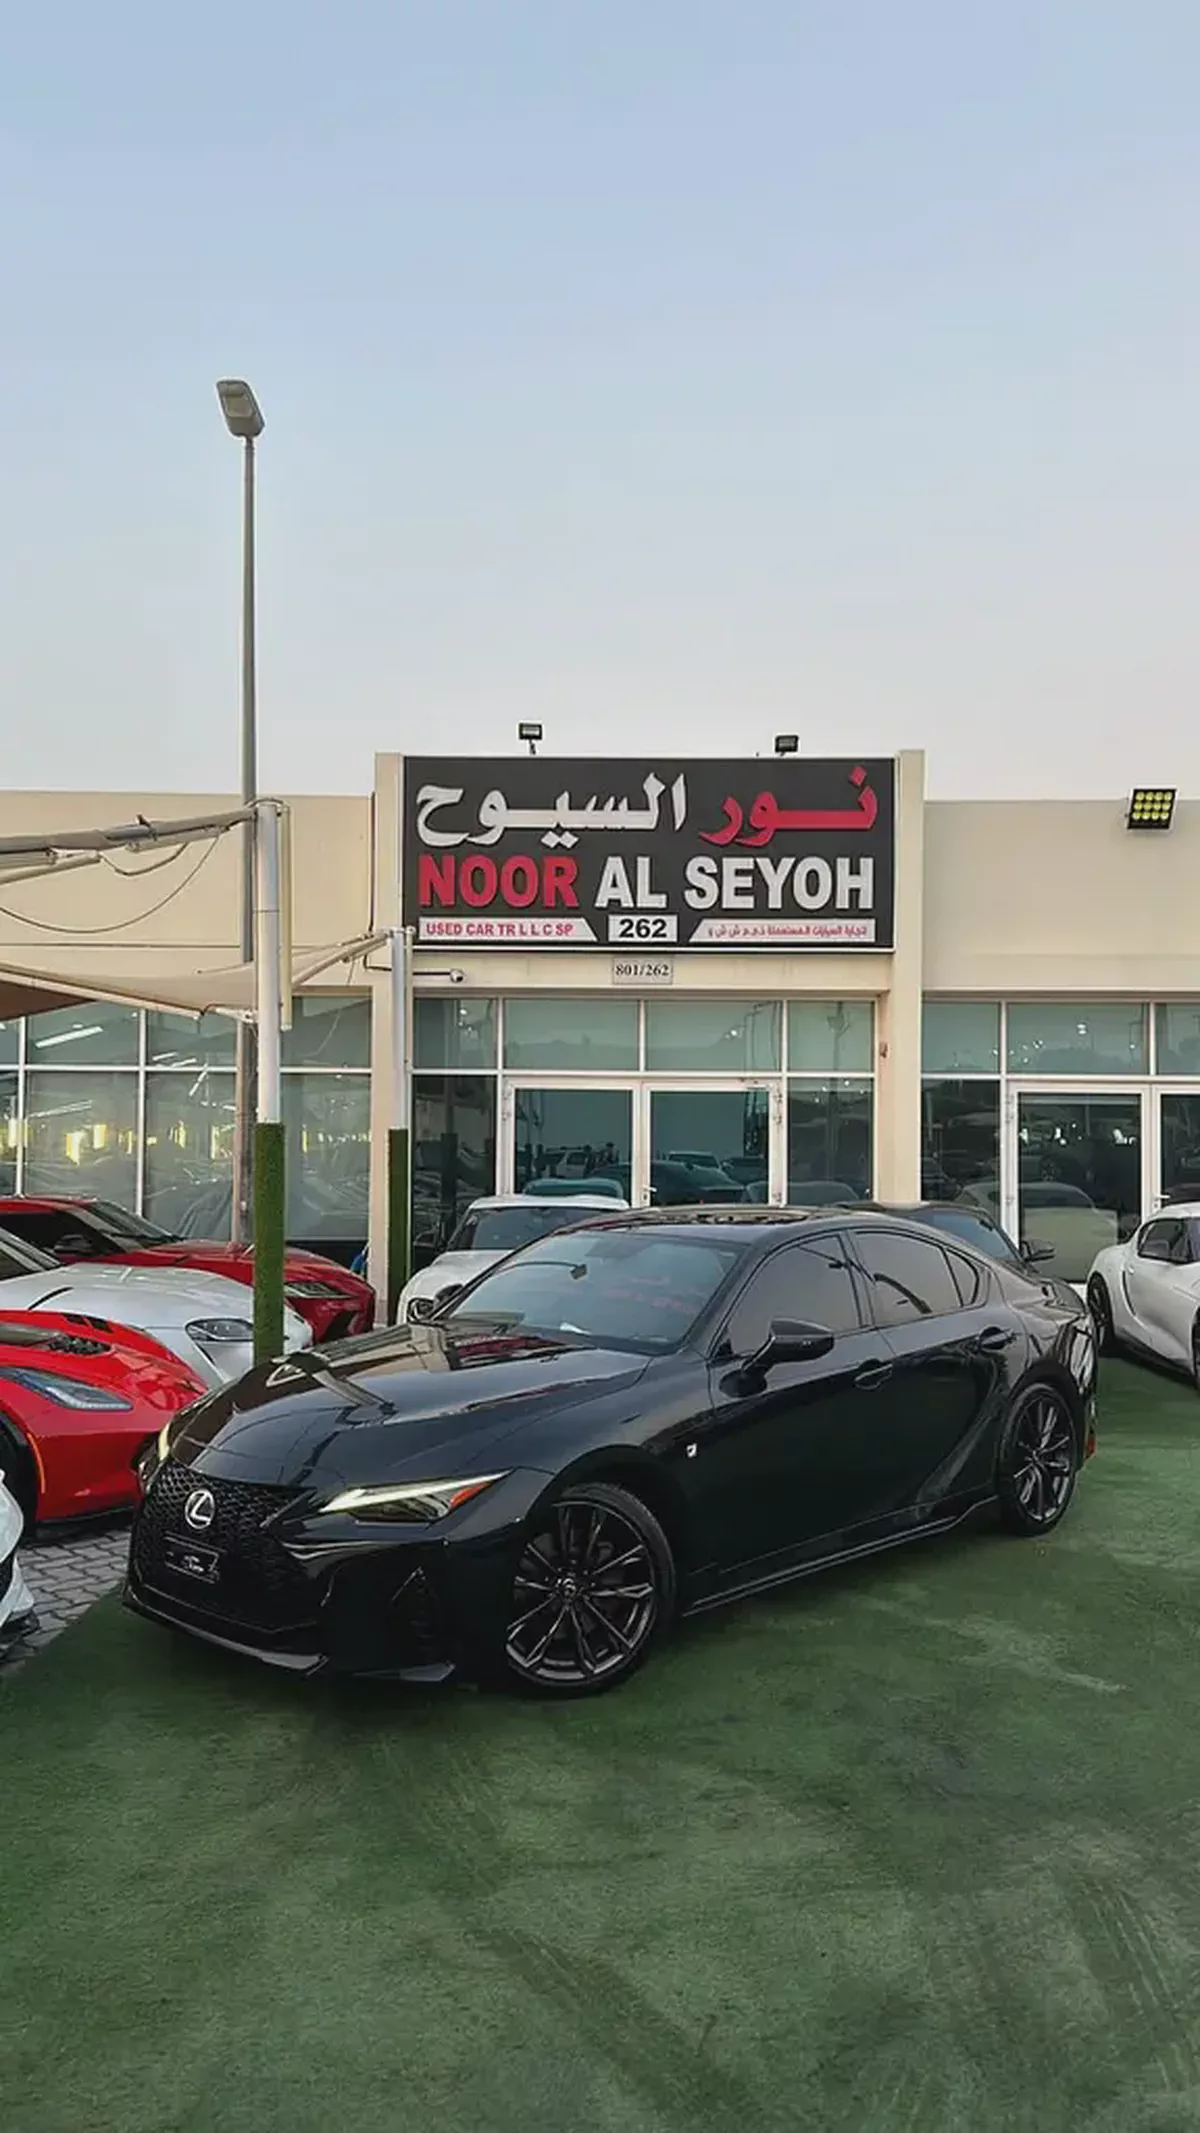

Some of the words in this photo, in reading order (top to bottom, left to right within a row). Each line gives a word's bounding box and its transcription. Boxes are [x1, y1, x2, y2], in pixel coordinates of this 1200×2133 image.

[416, 772, 687, 849] السيوح
[700, 765, 878, 847] نور
[417, 853, 580, 909] NOOR
[594, 855, 668, 910] AL
[684, 855, 875, 911] SEYOH
[426, 923, 462, 936] USED
[466, 923, 494, 936] CAR
[555, 923, 574, 936] SP
[618, 917, 668, 939] 262
[615, 963, 669, 976] 801/262
